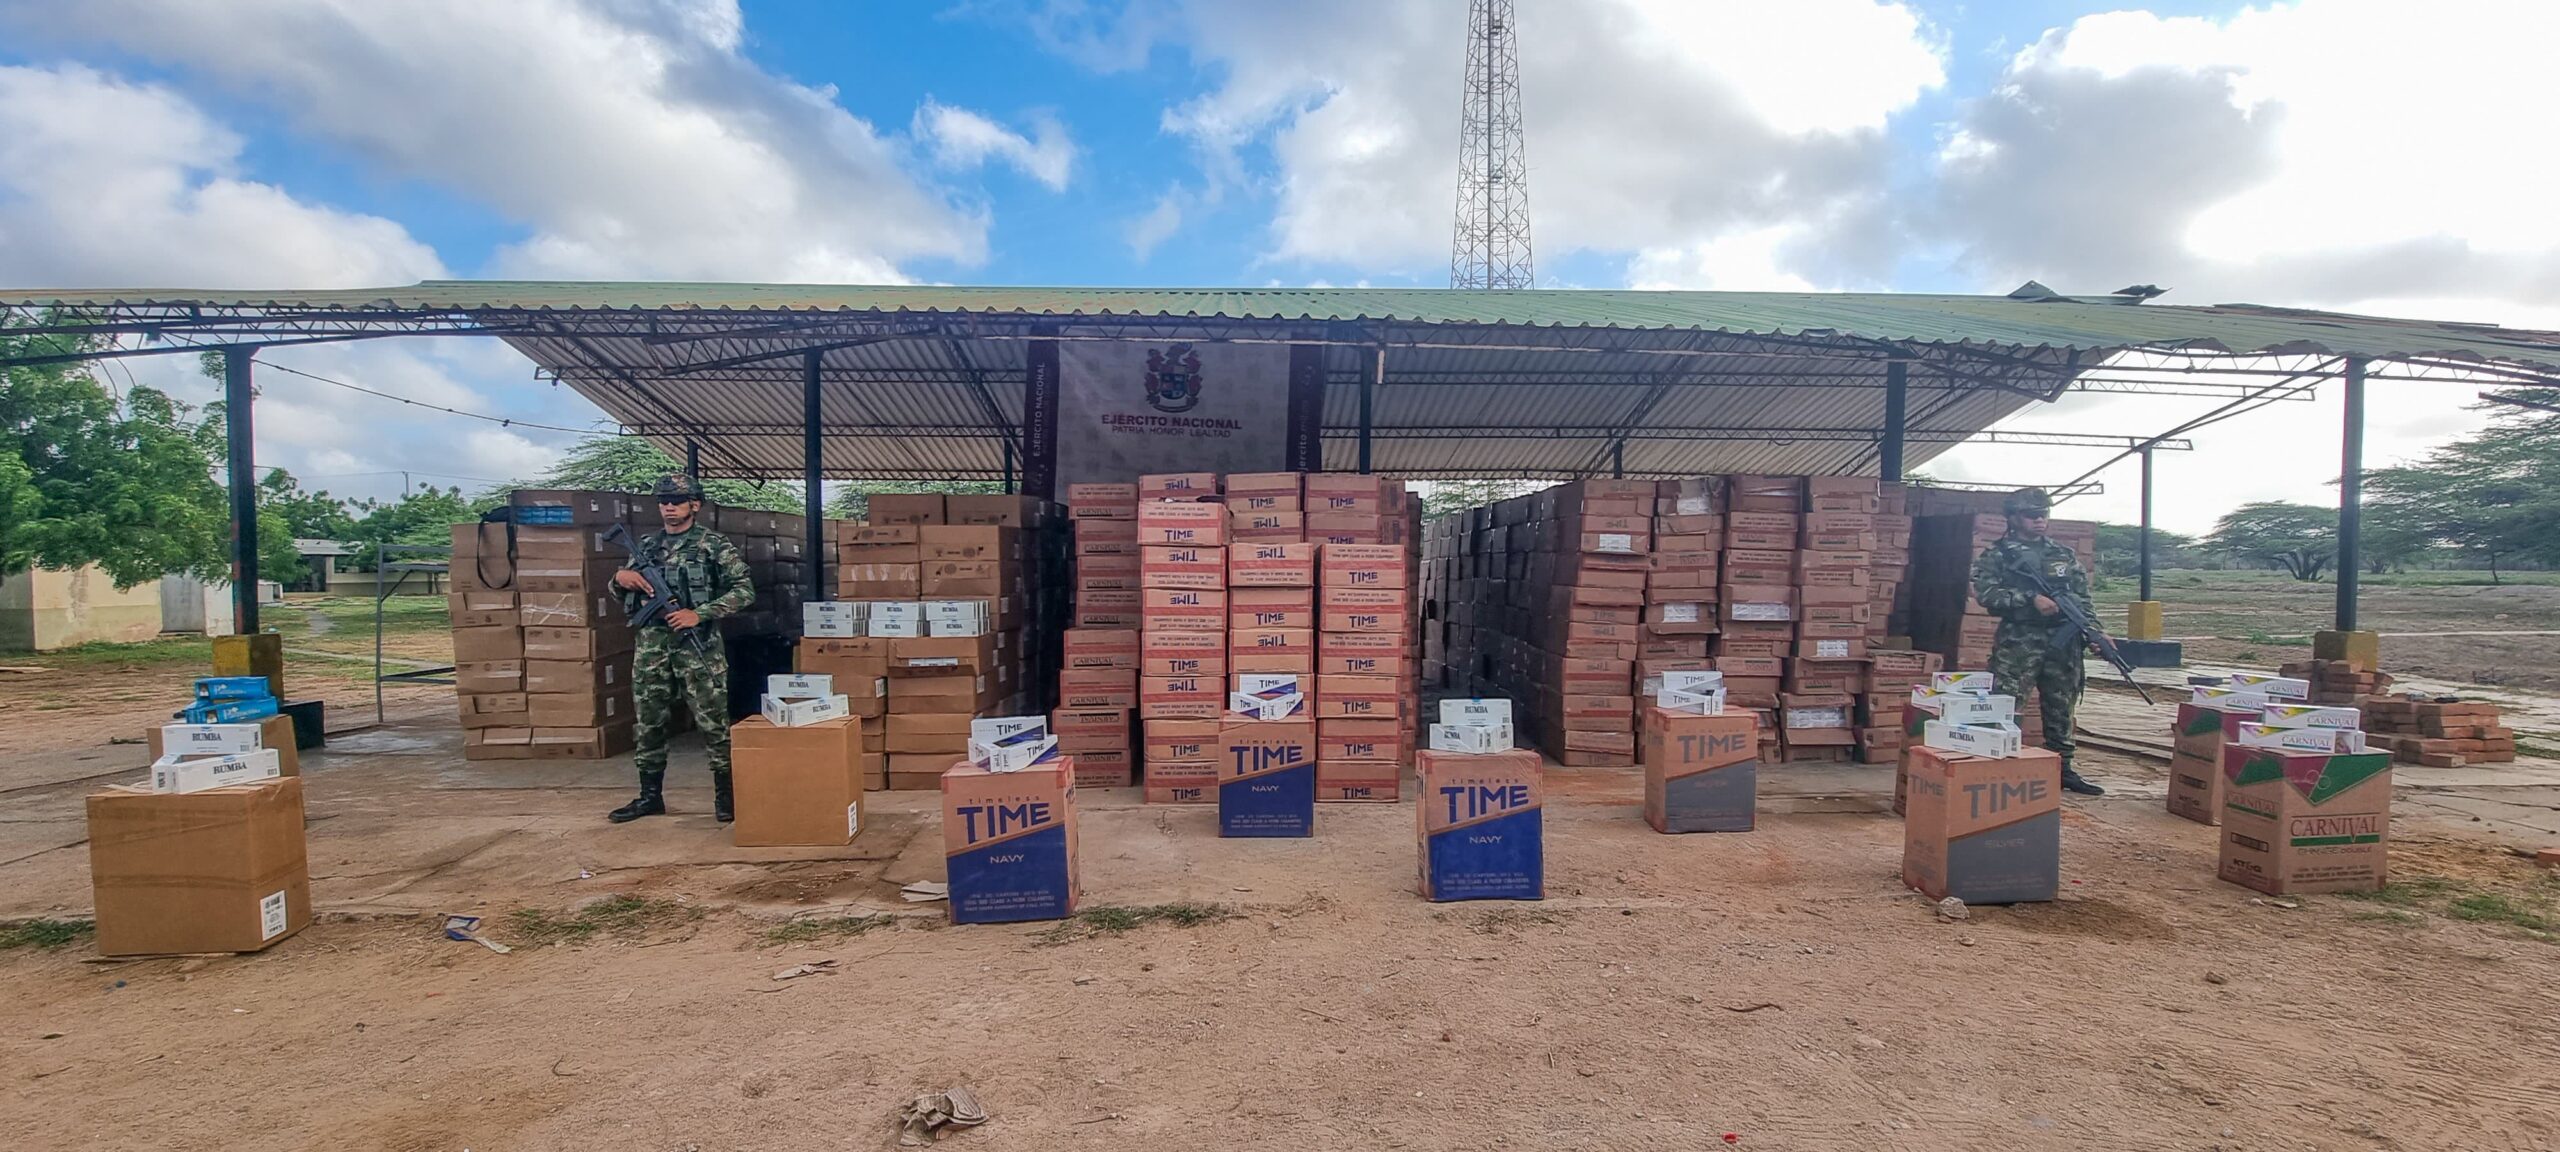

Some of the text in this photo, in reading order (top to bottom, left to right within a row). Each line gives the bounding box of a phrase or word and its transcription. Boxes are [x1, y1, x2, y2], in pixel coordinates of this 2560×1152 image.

[1033, 364, 1045, 457] EJÉRCITO NACIONAL
[1102, 414, 1242, 429] EJÉRCITO NACIONAL
[1112, 426, 1230, 438] PATRIA HONOR LEALTAD
[1165, 478, 1192, 490] TIME
[1248, 498, 1275, 509] TIME
[1328, 497, 1354, 509] TIME
[1253, 516, 1280, 528] TIME
[1165, 529, 1193, 542] TIME
[1169, 550, 1198, 562] TIME
[1257, 546, 1286, 558] TIME
[1349, 571, 1378, 583] TIME
[1170, 593, 1199, 605] TIME
[1256, 613, 1285, 625] TIME
[1349, 616, 1378, 628] TIME
[1258, 634, 1287, 646] TIME
[1169, 660, 1198, 673] TIME
[1346, 659, 1375, 671] TIME
[1168, 679, 1197, 691] TIME
[1259, 679, 1280, 689] TIME
[1684, 675, 1705, 686] TIME
[2265, 685, 2305, 695] CARNIVAL
[1673, 695, 1690, 704] TIME
[1342, 701, 1371, 714] TIME
[1464, 706, 1489, 714] RUMBA
[1970, 704, 1992, 712] RUMBA
[2307, 716, 2354, 728] CARNIVAL
[996, 723, 1023, 736] TIME
[192, 733, 222, 742] RUMBA
[1949, 731, 1976, 742] RUMBA
[2282, 736, 2330, 748] CARNIVAL
[1027, 743, 1044, 759] TIME
[1170, 745, 1200, 757] TIME
[1344, 744, 1373, 756] TIME
[1677, 733, 1747, 764] TIME
[1229, 745, 1303, 776] TIME
[213, 762, 247, 775] RUMBA
[1909, 773, 1945, 797] TIME
[1172, 788, 1201, 801] TIME
[1342, 787, 1371, 800] TIME
[1963, 779, 2049, 820] TIME
[969, 795, 1040, 805] timeless
[1440, 785, 1529, 824] TIME
[957, 802, 1051, 845] TIME
[2290, 816, 2380, 838] CARNIVAL
[1469, 835, 1503, 845] NAVY
[990, 854, 1024, 864] NAVY
